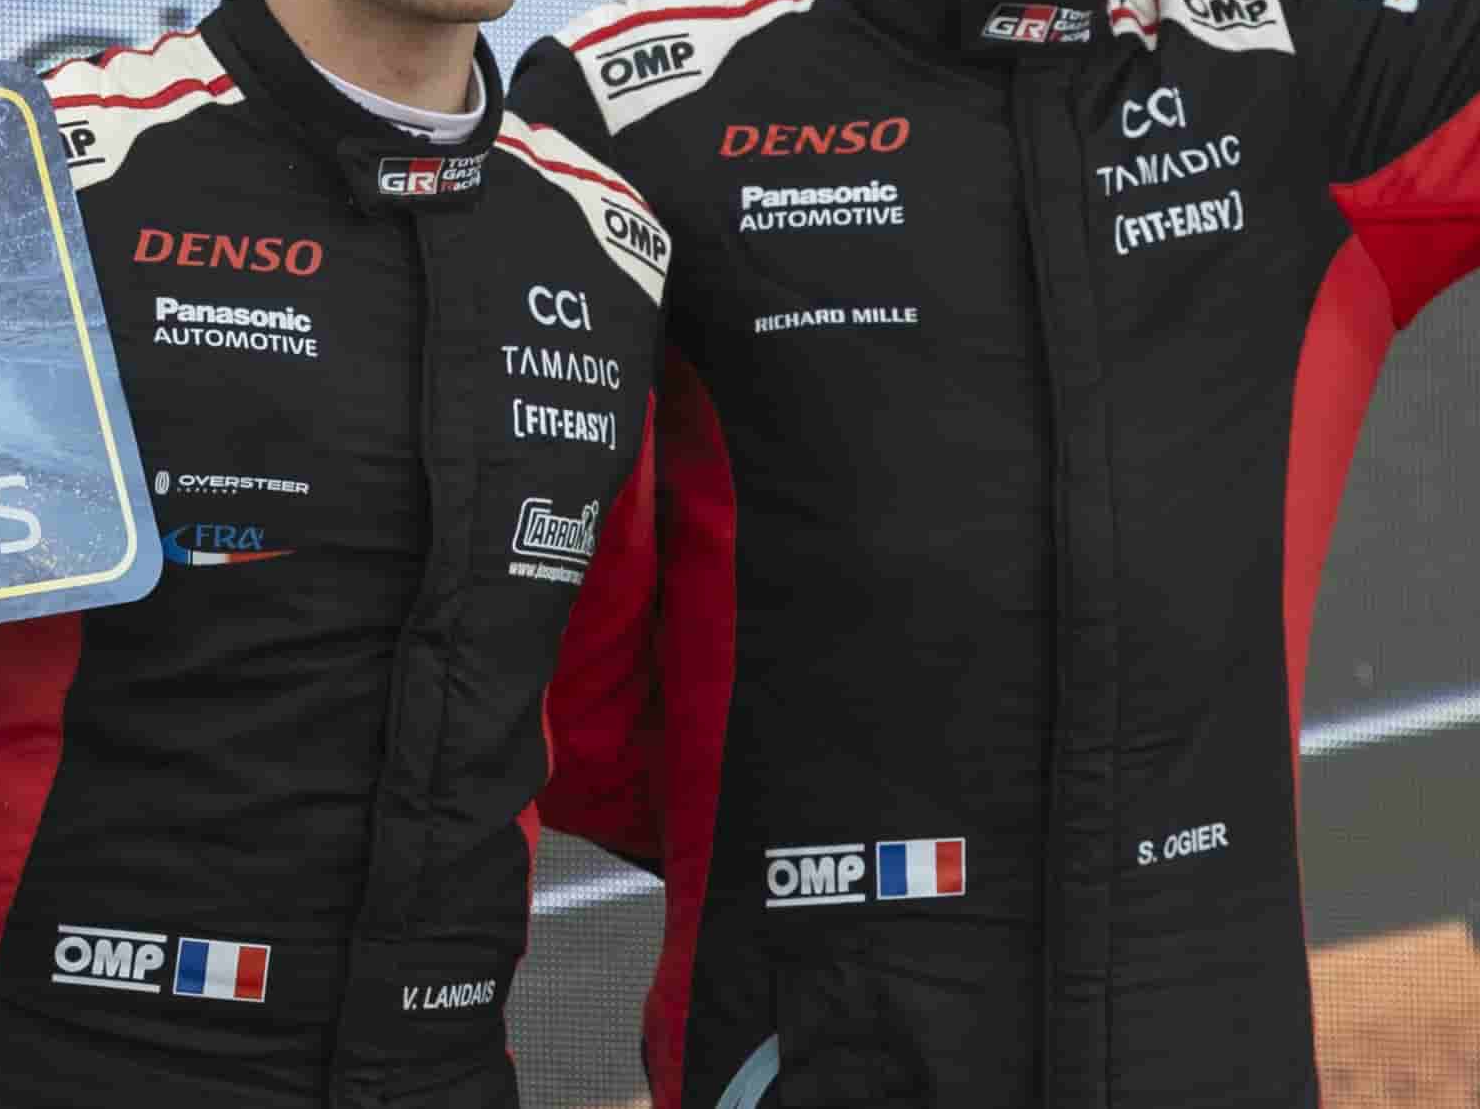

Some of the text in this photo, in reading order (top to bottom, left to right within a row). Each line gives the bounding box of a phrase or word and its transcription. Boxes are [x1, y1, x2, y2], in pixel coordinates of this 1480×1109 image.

[987, 16, 1047, 40] GR
[600, 41, 695, 87] OMP
[718, 116, 911, 158] DENSO
[381, 171, 436, 192] GR
[1096, 134, 1241, 196] TAMADIC
[741, 180, 898, 210] Panasonic
[604, 209, 667, 262] OMP
[739, 206, 906, 233] AUTOMOTIVE
[133, 228, 324, 276] DENSO
[155, 296, 313, 333] Panasonic
[754, 305, 919, 334] RICHARD MILLE
[153, 326, 319, 358] AUTOMOTIVE
[501, 345, 621, 390] TAMADIC
[178, 474, 310, 495] OVERSTEER
[1137, 821, 1230, 866] S. OGIER
[766, 854, 866, 897] OMP
[54, 936, 166, 981] OMP
[401, 979, 496, 1011] V. LANDAIS
